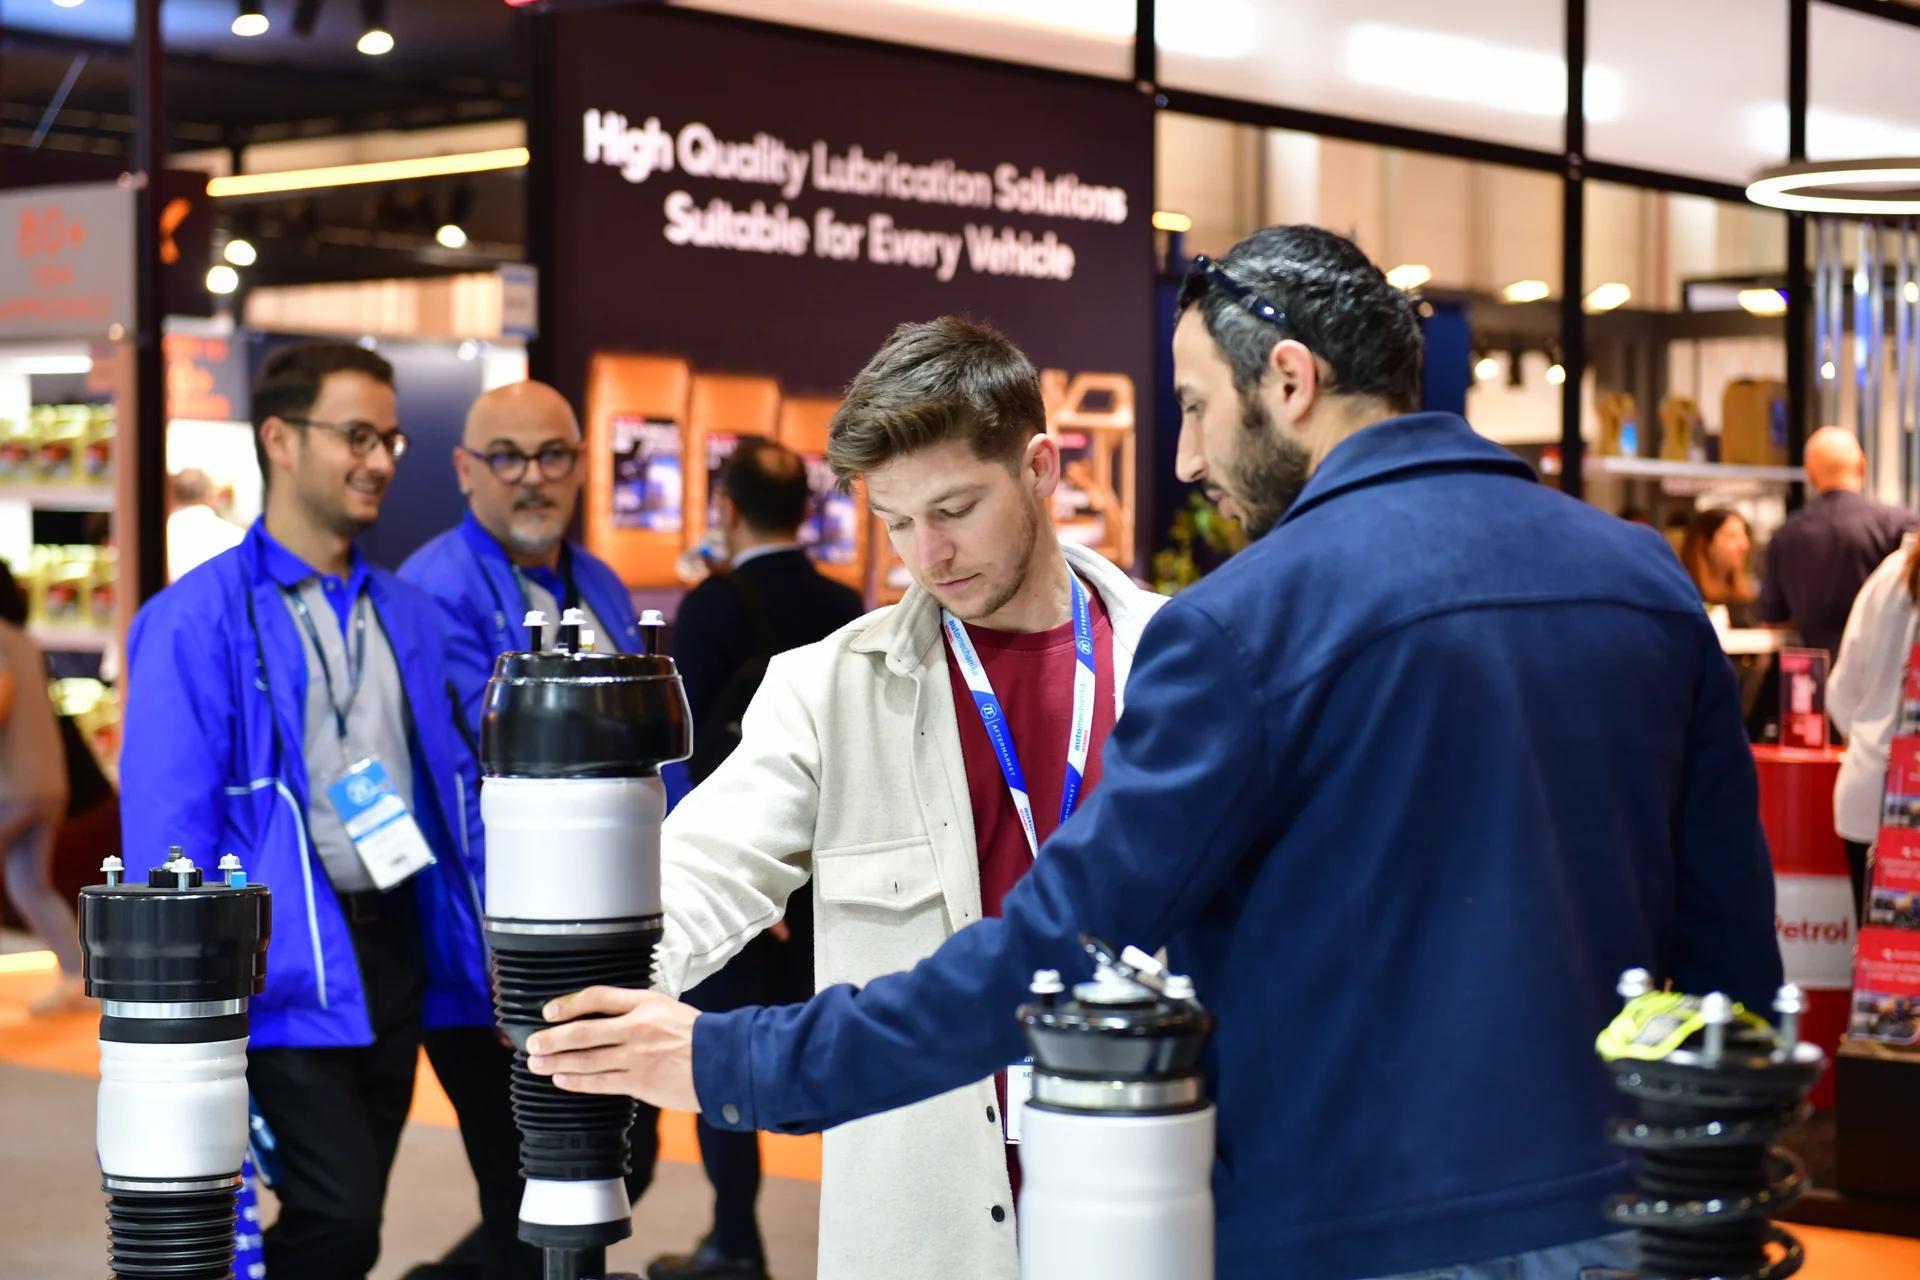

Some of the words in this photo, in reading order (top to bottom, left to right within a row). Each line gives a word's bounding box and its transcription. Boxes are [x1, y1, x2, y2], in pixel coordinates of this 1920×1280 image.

[583, 108, 675, 183] High
[675, 122, 810, 199] Quality
[812, 139, 993, 208] Lubrication
[994, 162, 1128, 224] Solutions
[663, 190, 810, 256] Suitable
[814, 207, 866, 261] for
[868, 213, 963, 282] Every
[964, 223, 1076, 281] Vehicle
[1077, 589, 1088, 637] AFTERMARKET
[948, 619, 979, 676] automechanika
[1074, 683, 1087, 752] automechanika
[992, 724, 1016, 776] AFTERMARKET
